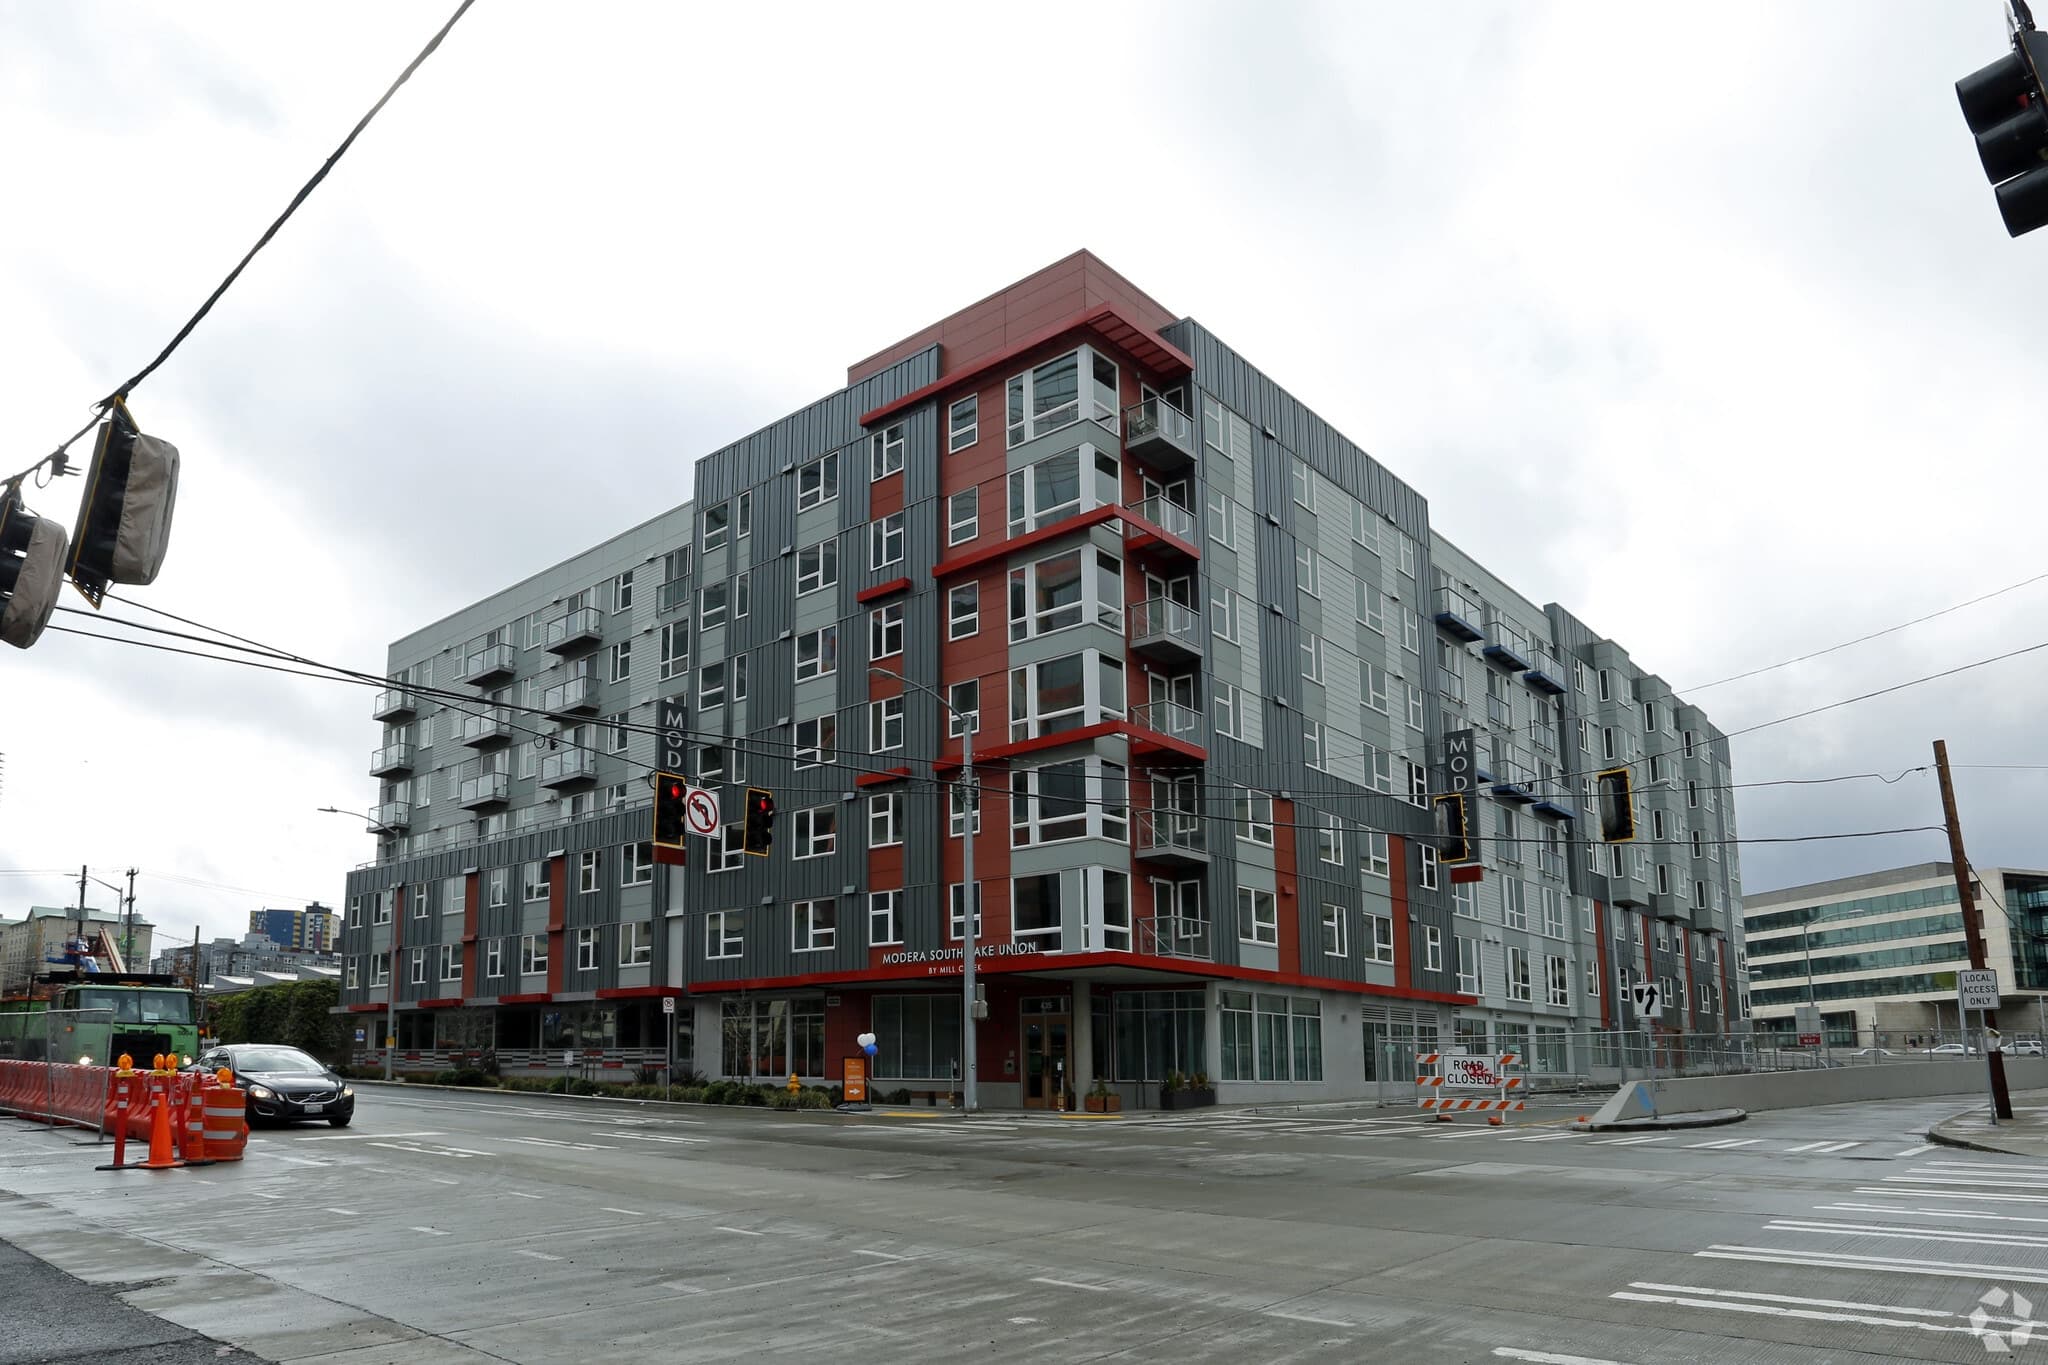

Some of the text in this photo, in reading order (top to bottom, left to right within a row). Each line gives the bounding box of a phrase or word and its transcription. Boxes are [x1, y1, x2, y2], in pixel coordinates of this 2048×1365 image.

[882, 942, 1036, 964] MODERA SOUTH AKE UNION
[928, 964, 982, 975] BY MILL CEK
[1965, 974, 1991, 983] LOCAL
[1964, 985, 1996, 994] ACCESS
[1970, 997, 1991, 1005] ONLY
[1453, 1060, 1484, 1070] ROAD
[1447, 1073, 1492, 1084] CLOSED
